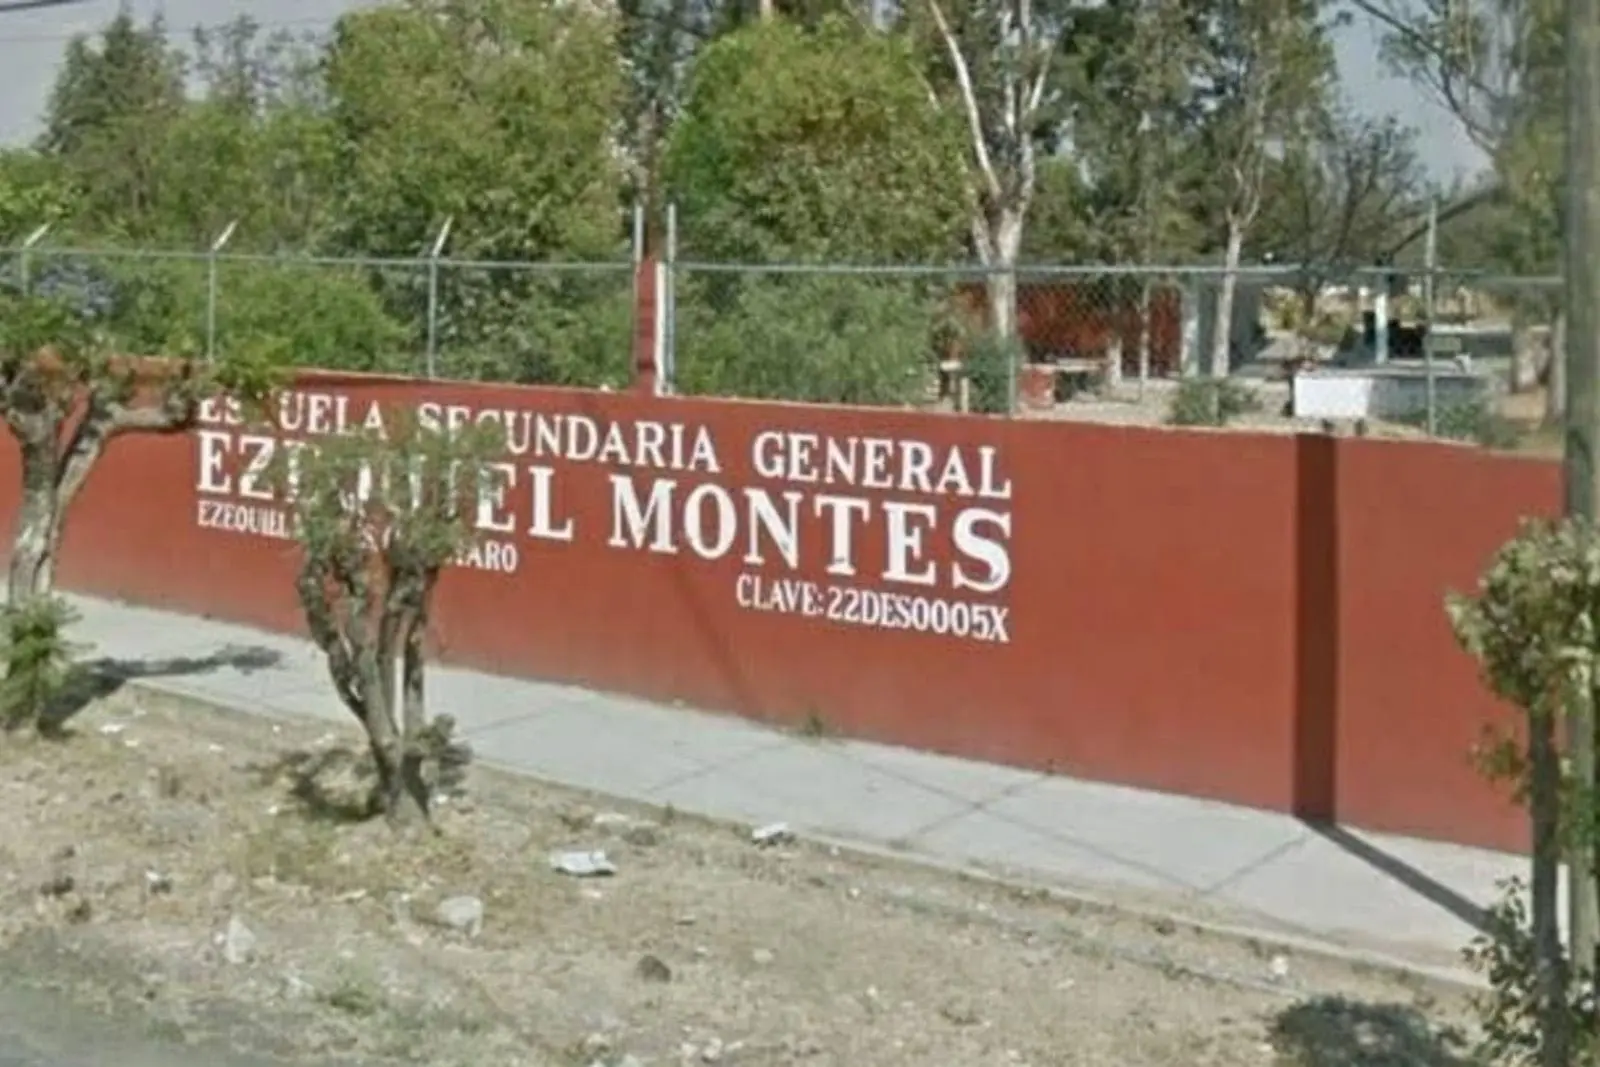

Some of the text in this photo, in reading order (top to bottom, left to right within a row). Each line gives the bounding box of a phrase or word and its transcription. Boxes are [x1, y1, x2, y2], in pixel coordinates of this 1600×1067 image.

[198, 392, 388, 440] ESUELA
[752, 431, 1012, 499] GENERAL
[608, 473, 1012, 592] MONTES
